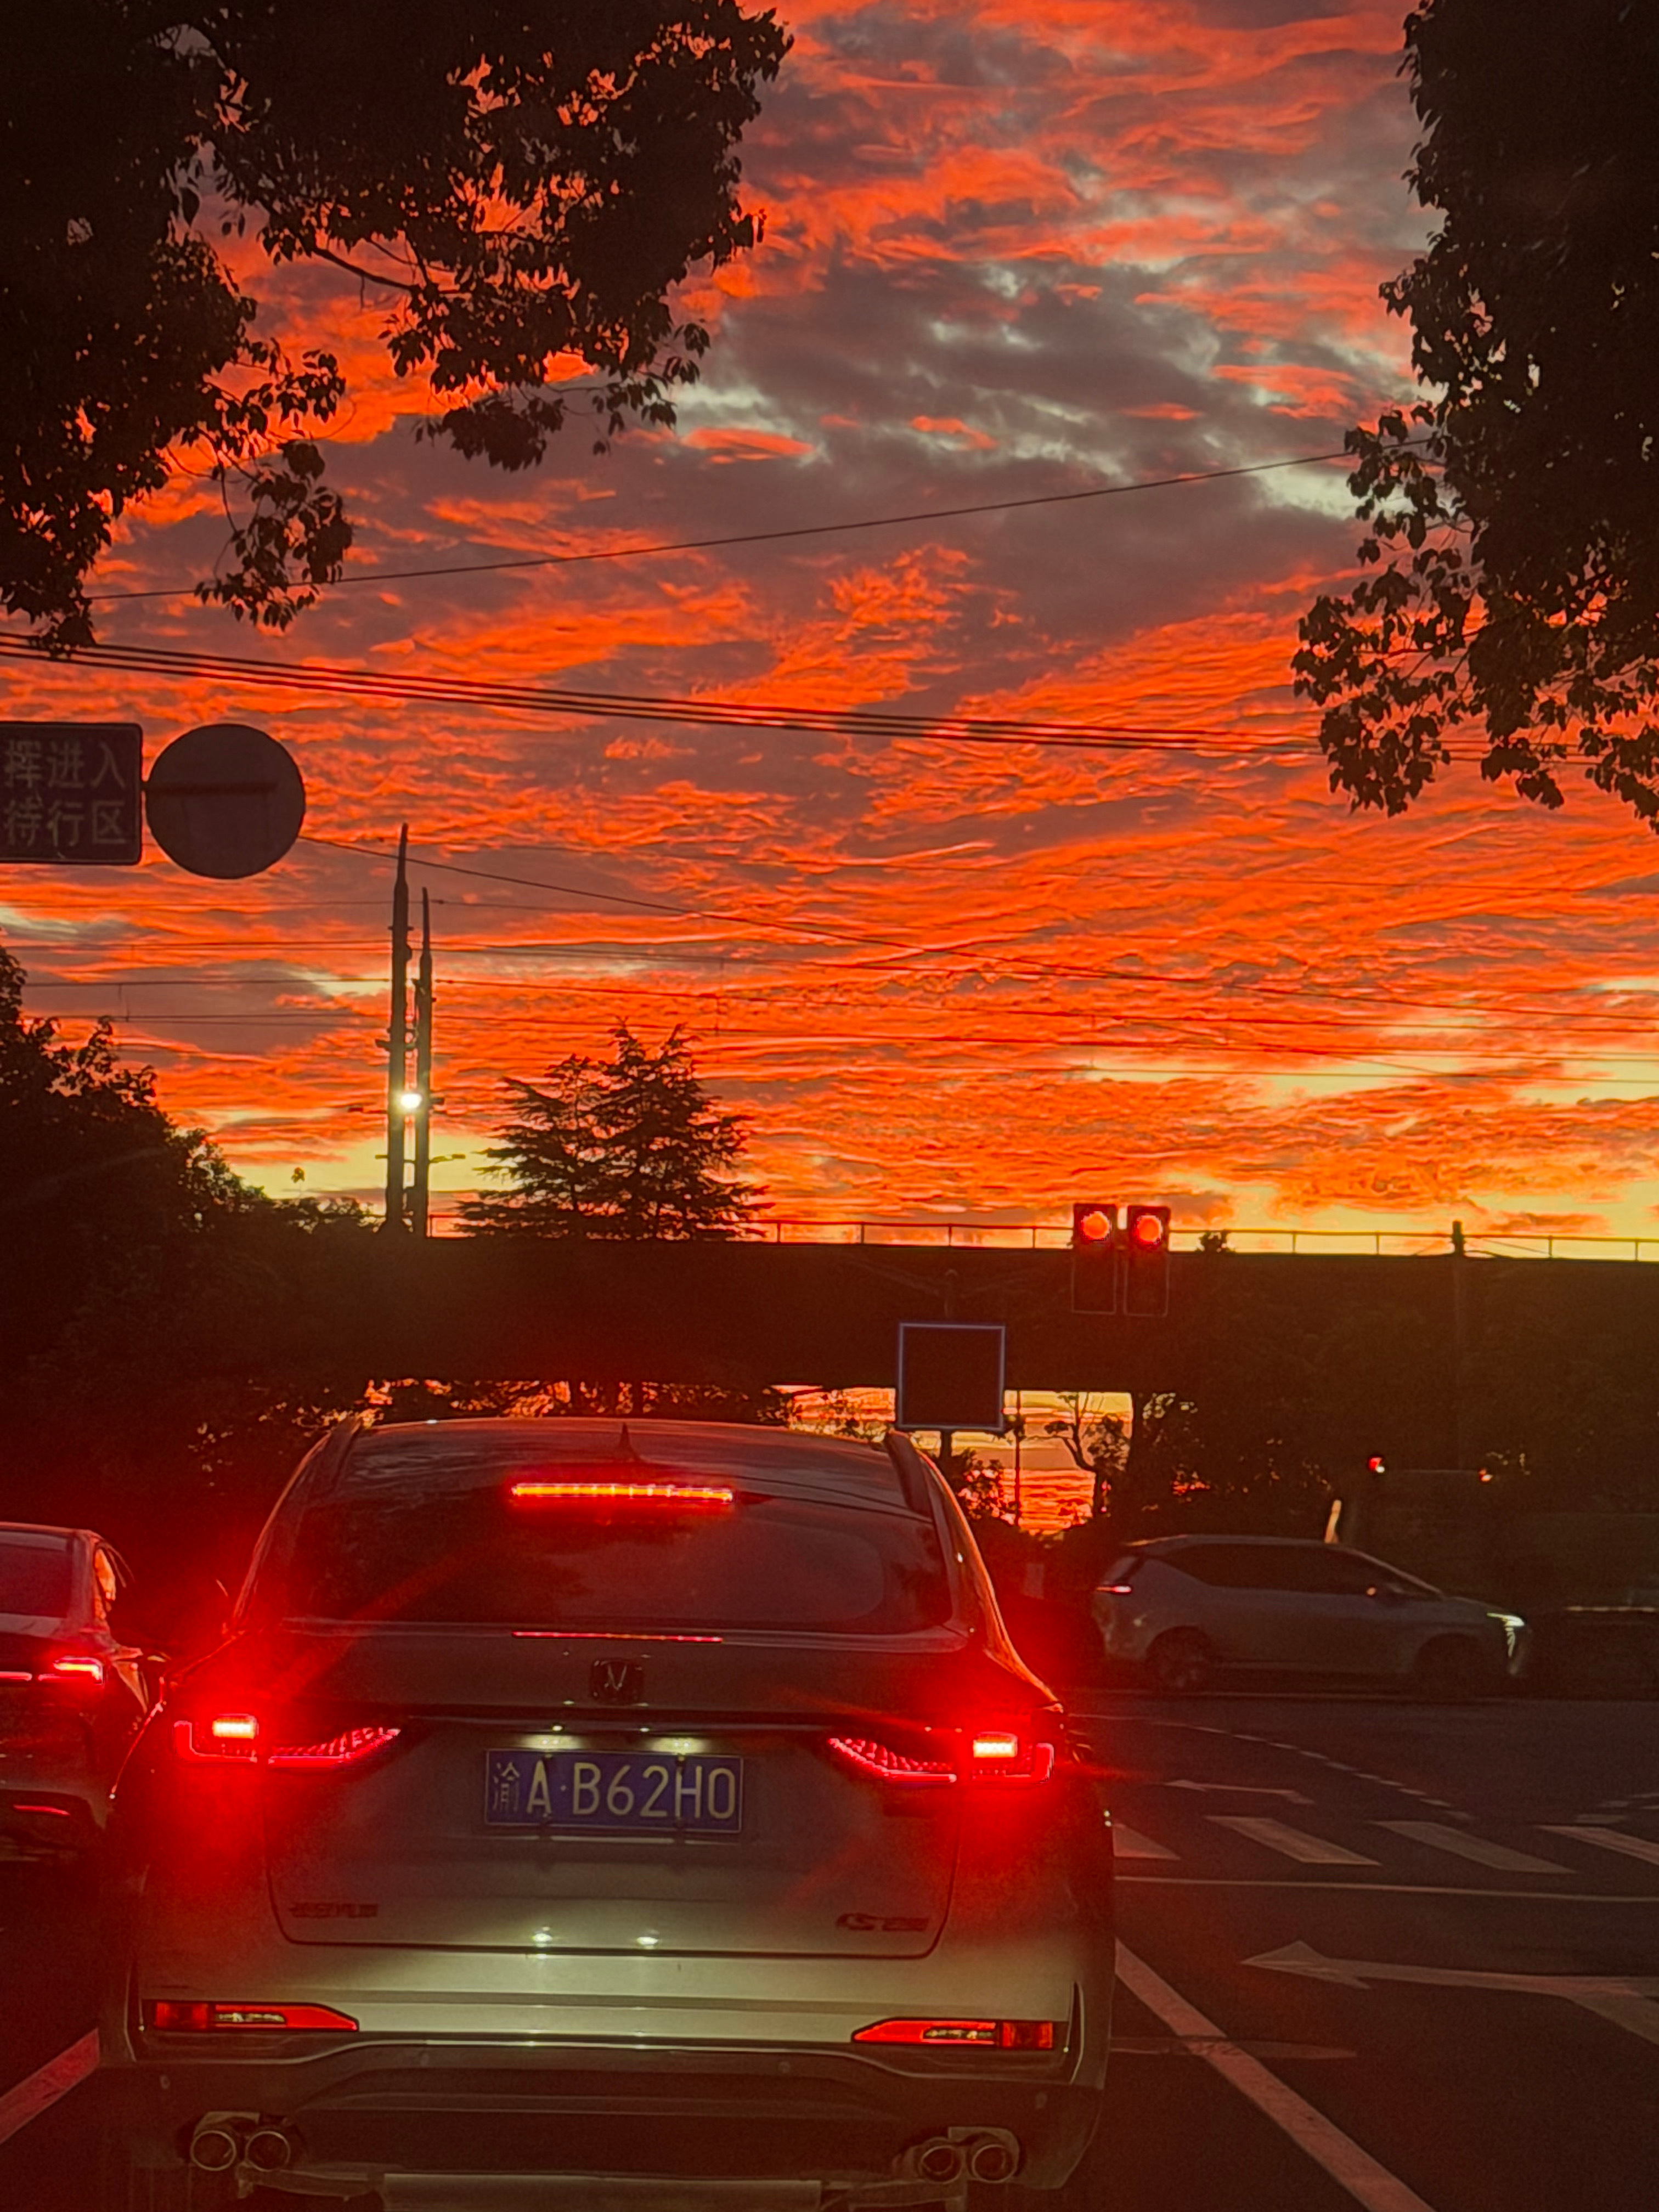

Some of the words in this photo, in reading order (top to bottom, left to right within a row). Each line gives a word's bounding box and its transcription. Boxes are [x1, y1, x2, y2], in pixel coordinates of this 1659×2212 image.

[4, 740, 126, 788] 挥进入
[4, 798, 127, 847] 待行区
